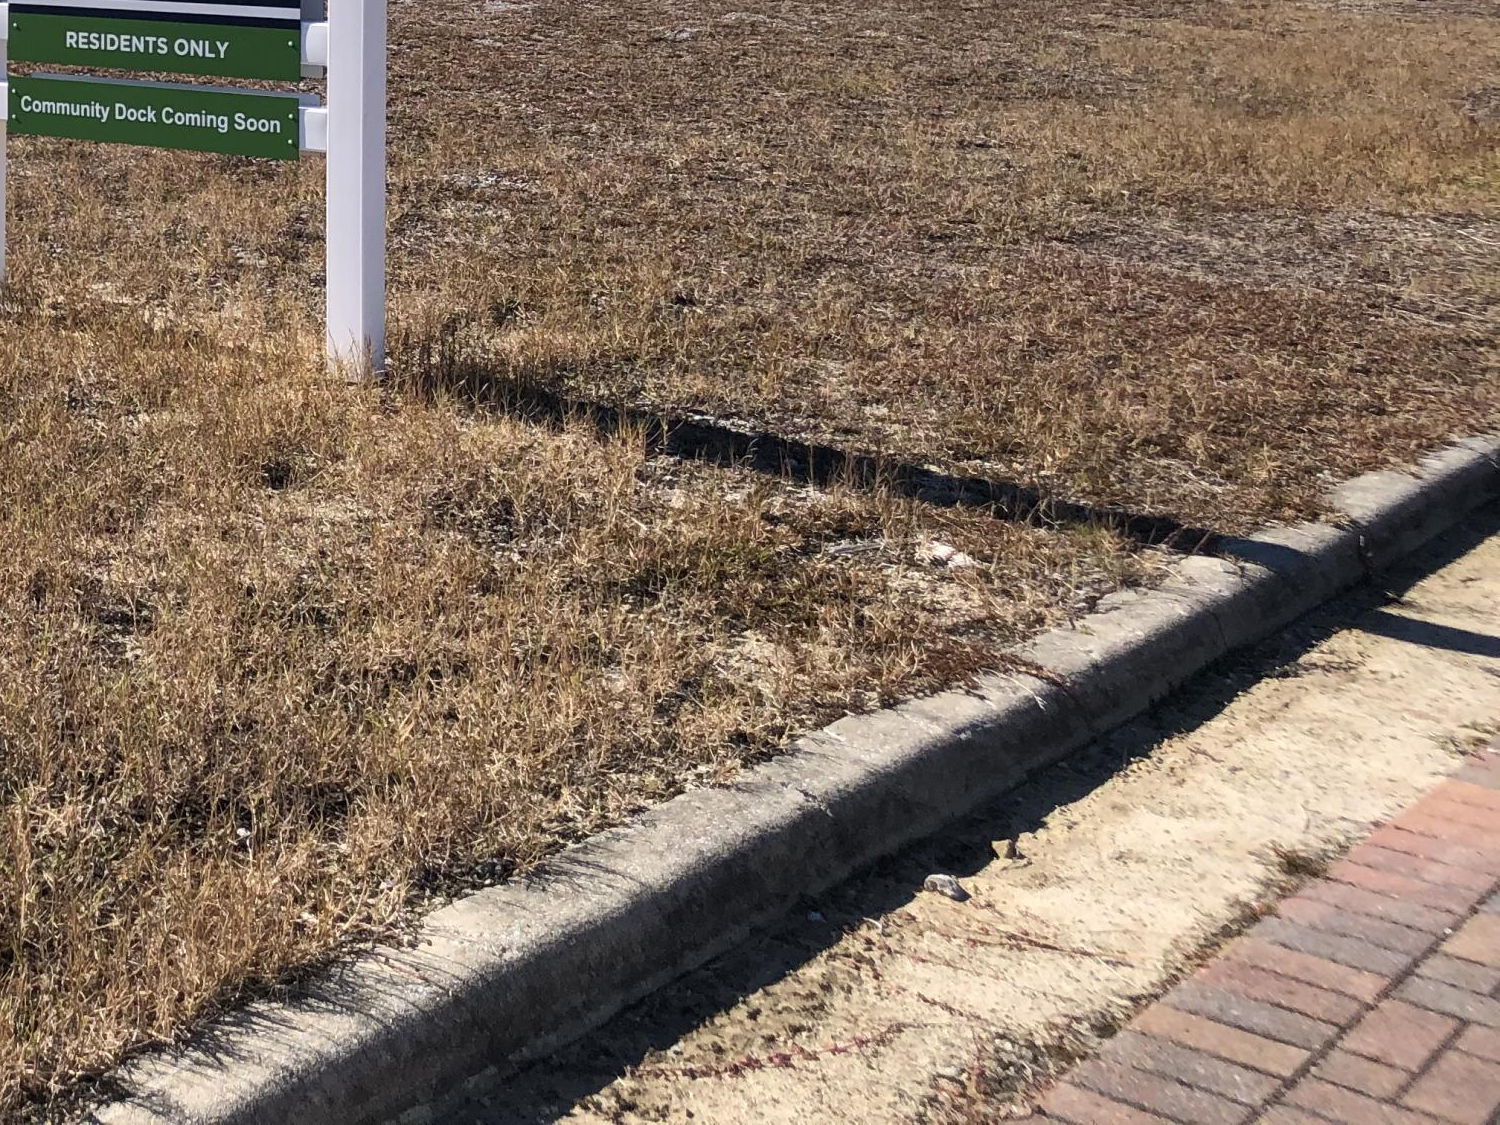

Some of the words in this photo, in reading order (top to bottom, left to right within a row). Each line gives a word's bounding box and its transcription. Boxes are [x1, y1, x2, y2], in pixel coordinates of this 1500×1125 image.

[65, 31, 169, 56] RESIDENTS
[173, 38, 230, 59] ONLY
[20, 95, 110, 123] Community
[114, 102, 157, 124] Dock
[161, 106, 229, 133] Coming
[233, 112, 282, 134] Soon
